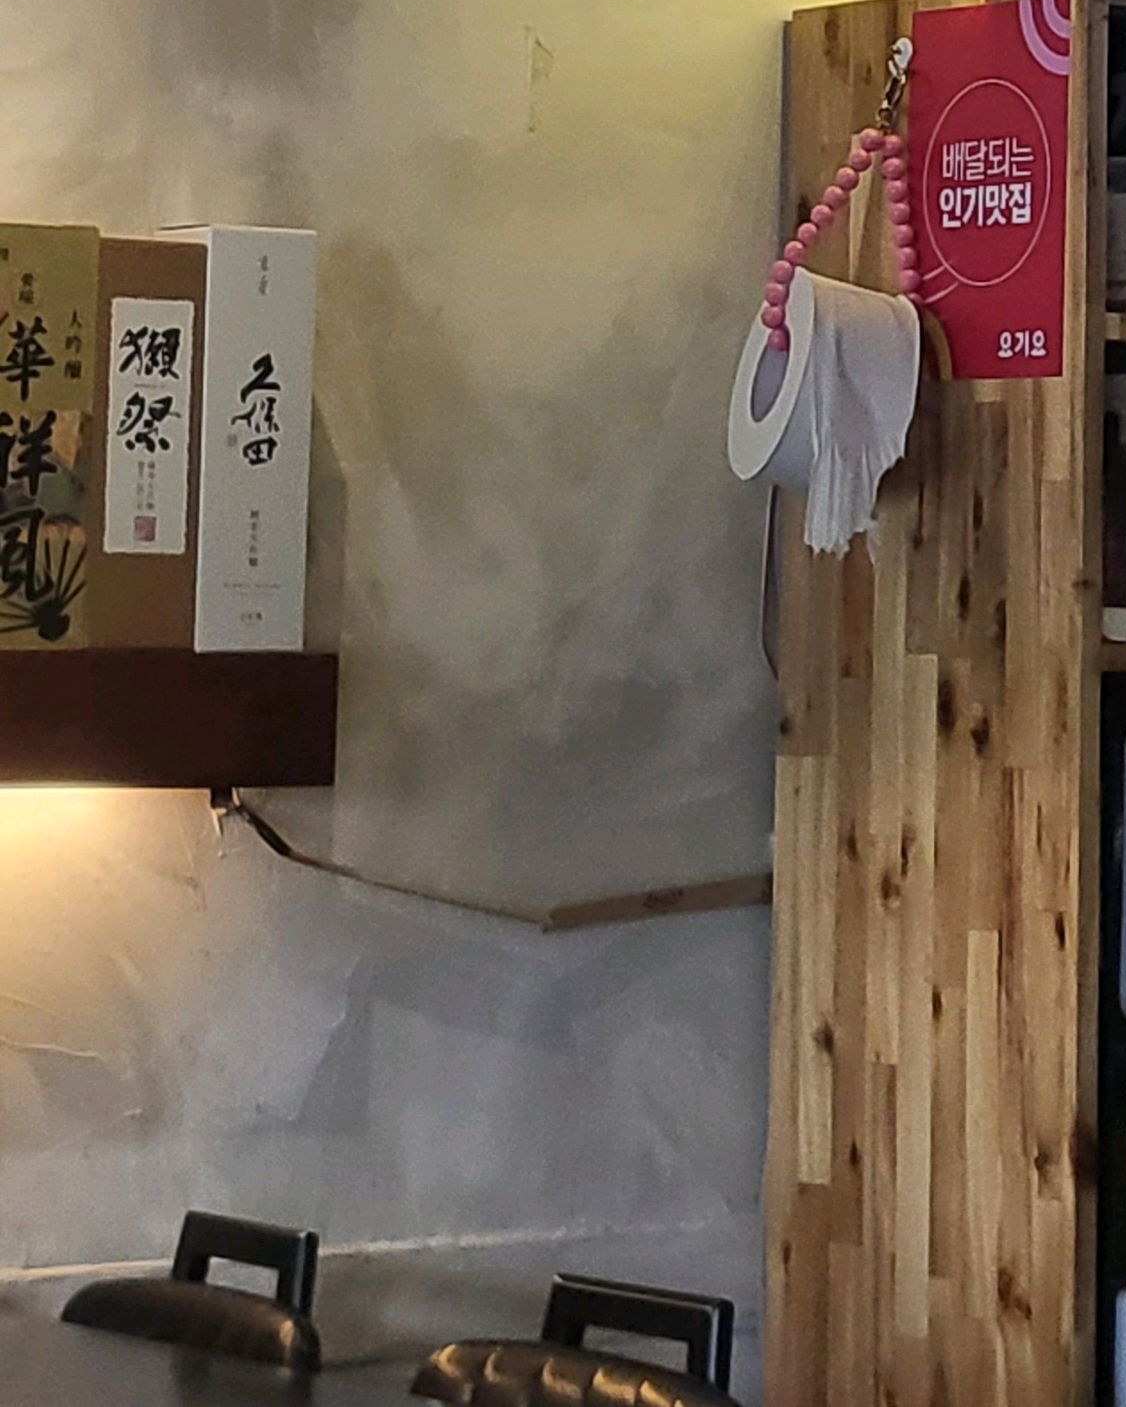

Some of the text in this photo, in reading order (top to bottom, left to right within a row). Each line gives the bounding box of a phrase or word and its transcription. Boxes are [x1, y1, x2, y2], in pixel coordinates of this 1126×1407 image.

[942, 137, 1034, 181] 배달되는
[939, 182, 1032, 228] 인기맛집
[997, 329, 1048, 358] 요기요
[116, 325, 183, 454] 獺祭
[230, 353, 282, 467] 久保田
